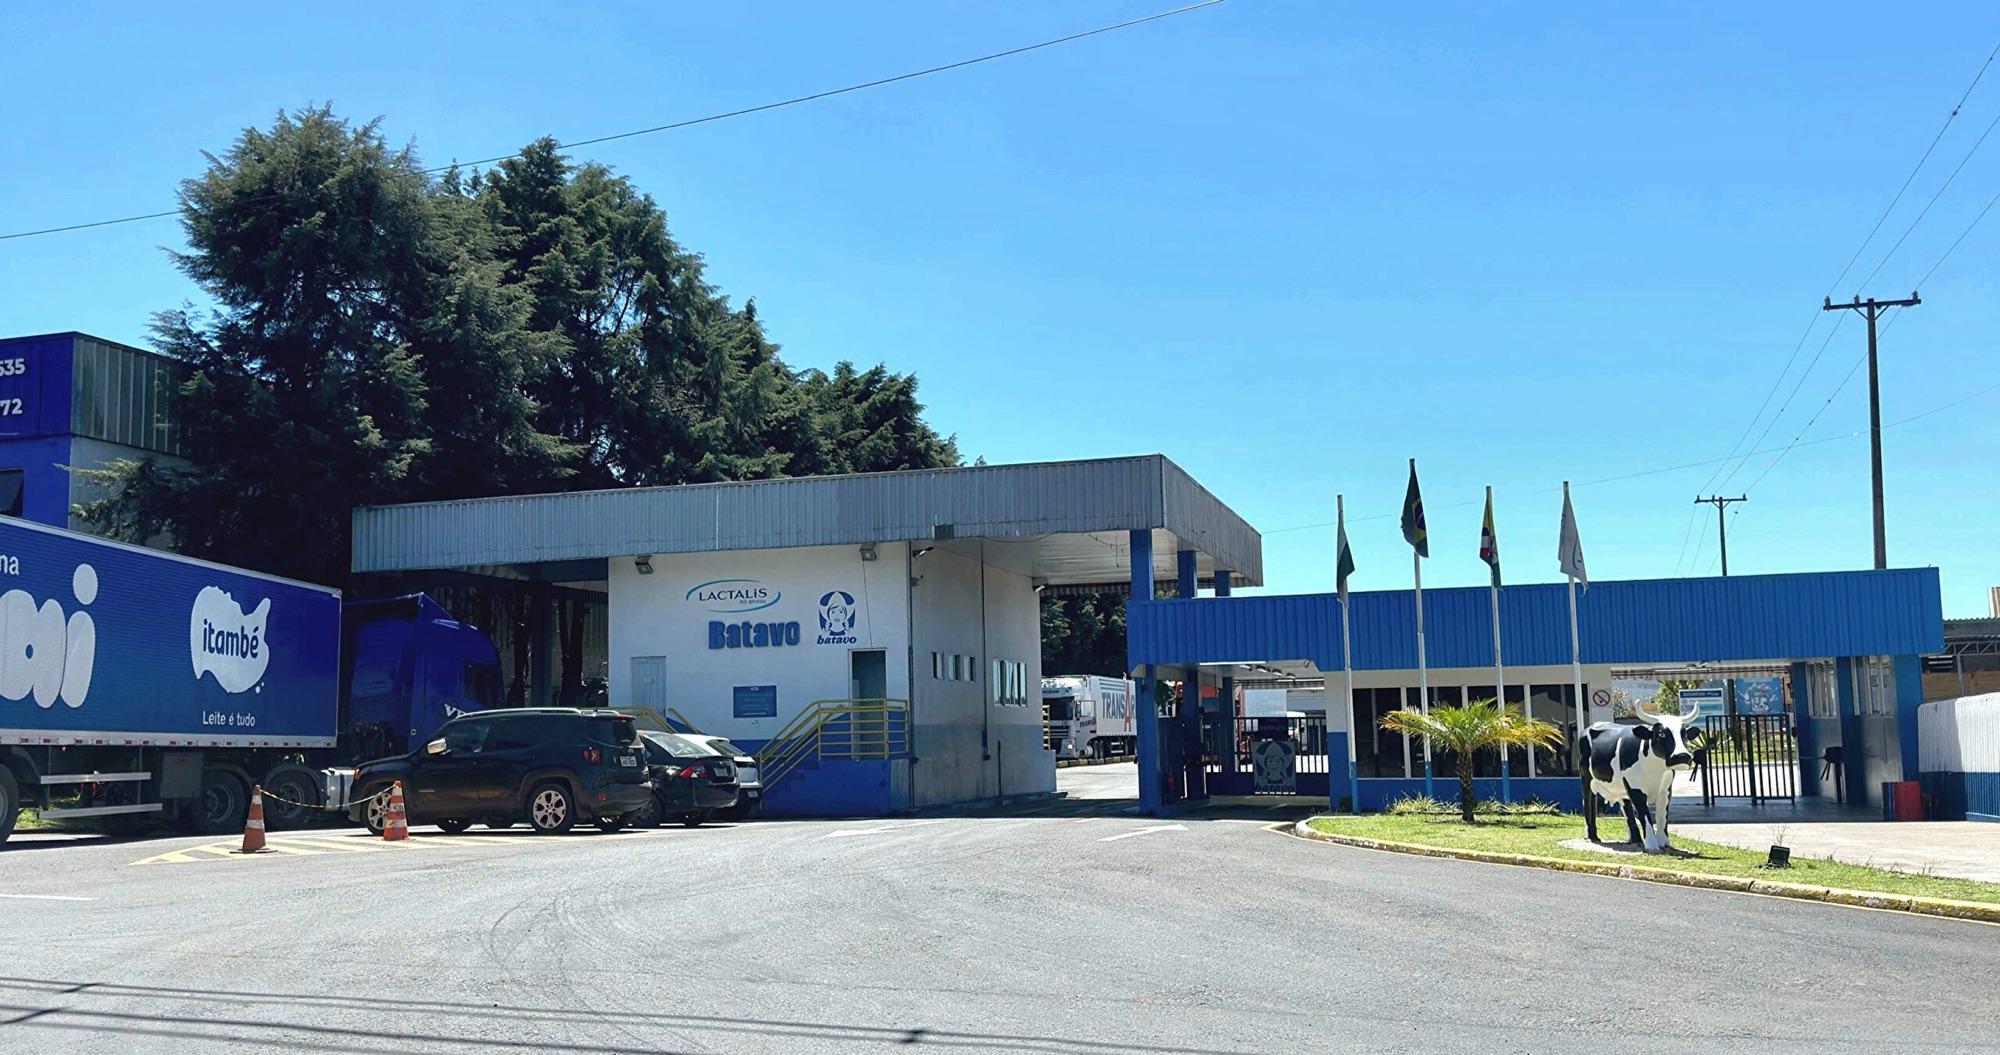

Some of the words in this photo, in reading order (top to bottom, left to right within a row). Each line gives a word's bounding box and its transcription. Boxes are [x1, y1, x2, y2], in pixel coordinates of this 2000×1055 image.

[203, 618, 259, 659] itambé
[708, 620, 800, 650] Batavo
[816, 634, 857, 645] batavo
[202, 710, 226, 726] Leite
[228, 712, 235, 726] é
[236, 712, 256, 727] tudo
